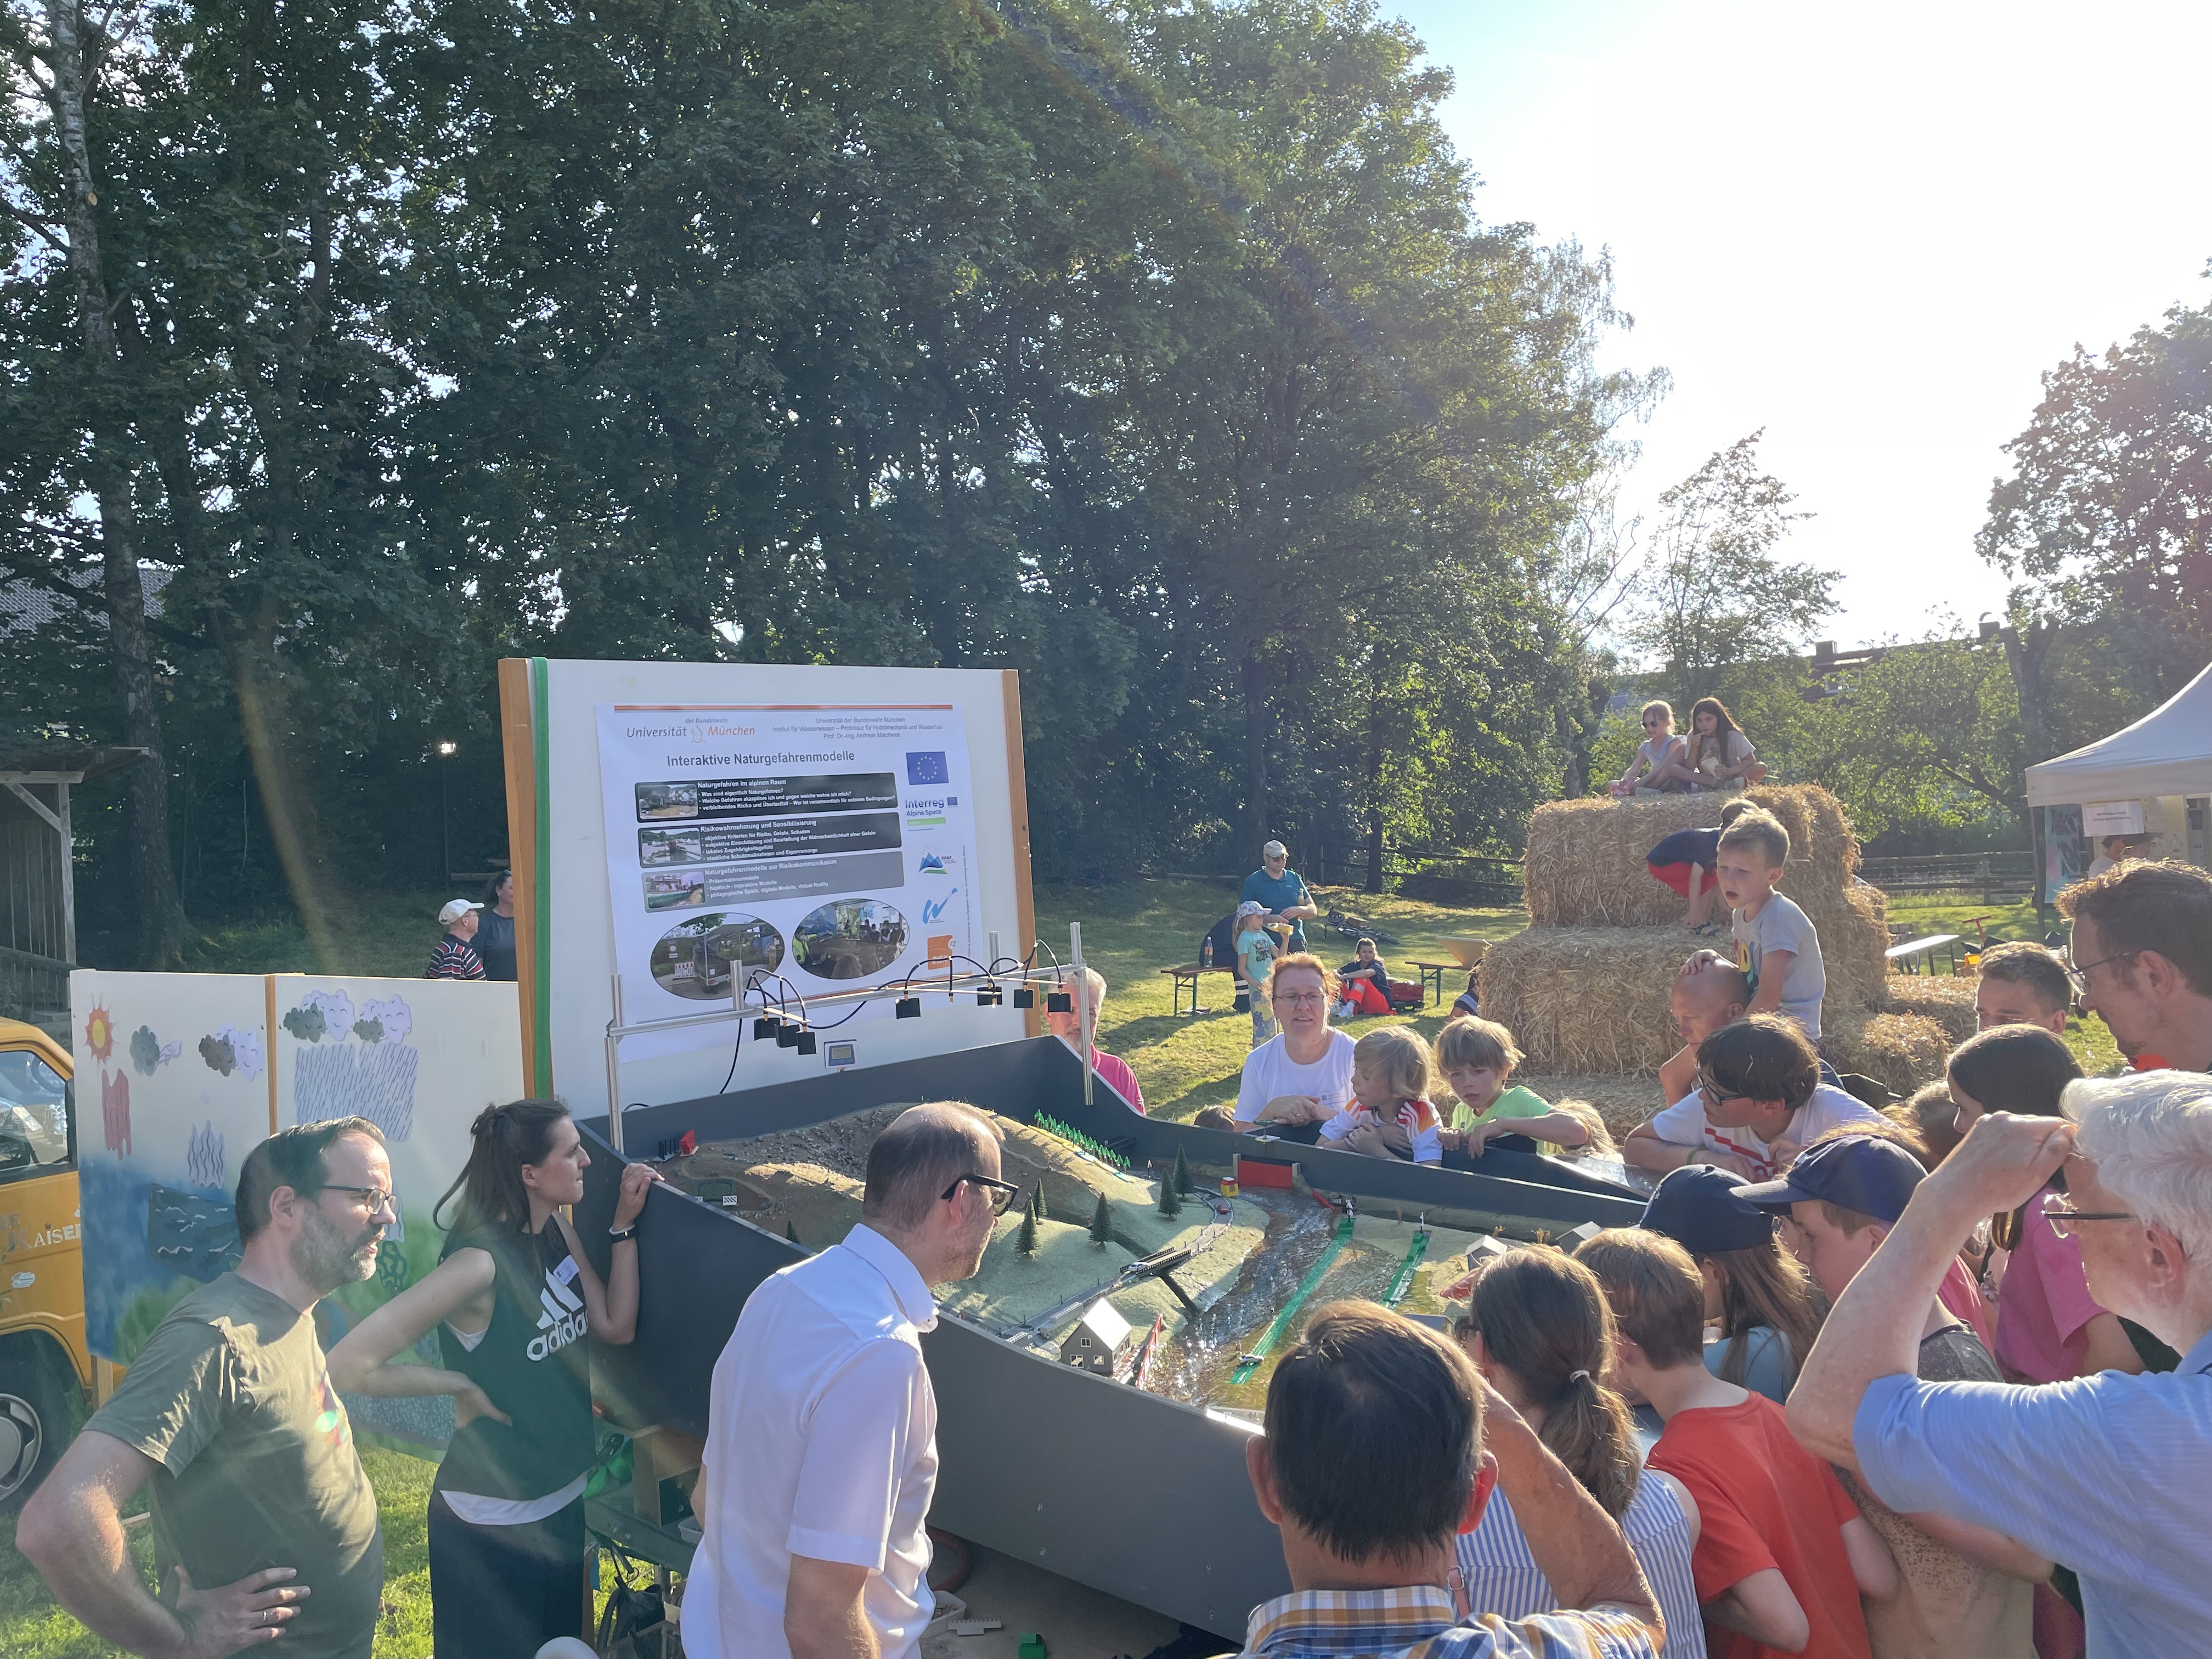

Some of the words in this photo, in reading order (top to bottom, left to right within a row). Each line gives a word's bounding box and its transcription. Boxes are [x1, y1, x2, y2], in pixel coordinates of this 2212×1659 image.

[627, 726, 687, 737] Universität
[708, 725, 755, 736] München
[667, 754, 731, 766] Interaktive
[734, 751, 855, 766] Naturgefahrenmodelle
[697, 781, 739, 789] Naturgefahren
[905, 799, 945, 809] Interreg
[700, 823, 760, 833] Risikowahrnehmung
[724, 844, 774, 853] Zugehörigkeitsgefühl
[704, 865, 768, 876] Naturgefahrenmodelle
[779, 859, 837, 869] Risikokommunikation
[709, 874, 760, 884] Präsentationsmodelle
[710, 890, 743, 899] pädagogische
[527, 1310, 588, 1361] adida
